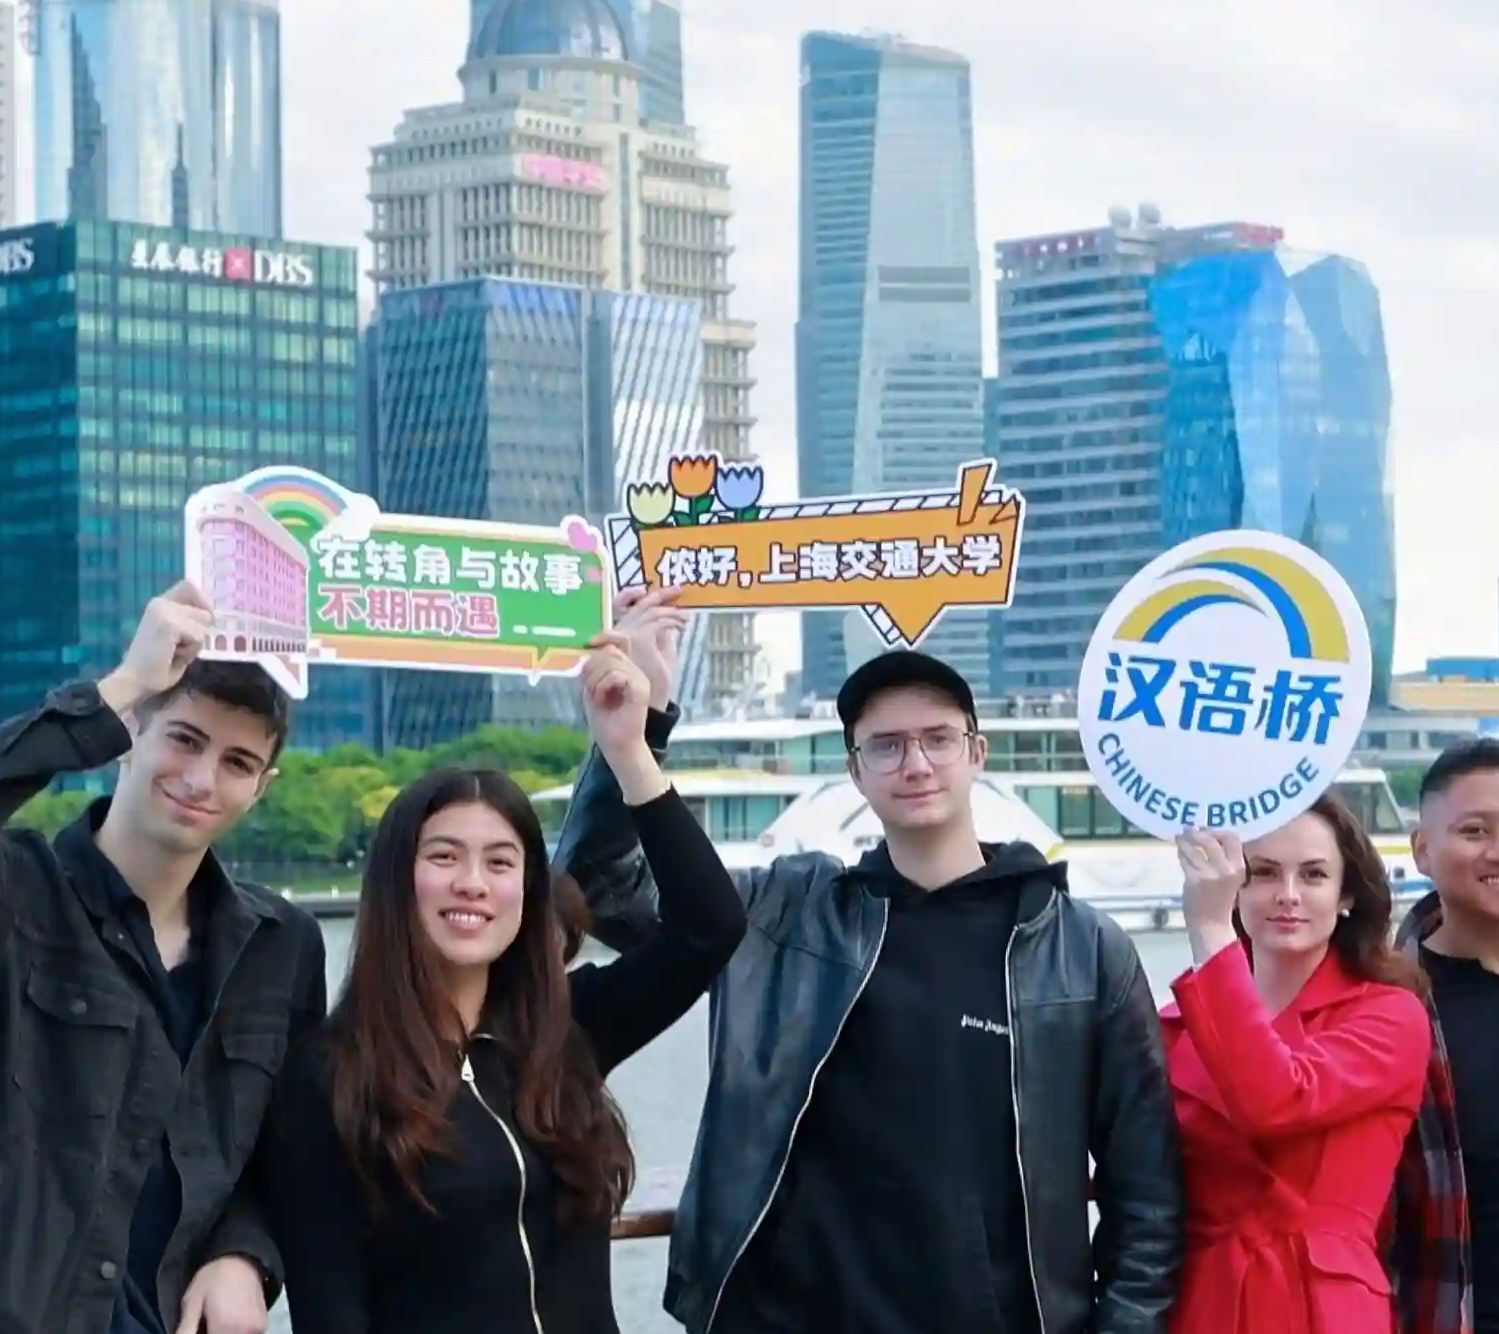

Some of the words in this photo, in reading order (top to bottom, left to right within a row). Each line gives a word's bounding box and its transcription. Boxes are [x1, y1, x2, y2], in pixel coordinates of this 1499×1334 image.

[318, 535, 583, 595] 在转角与故事
[317, 584, 500, 638] 不期而遇
[1098, 652, 1344, 745] 汉语桥
[1098, 732, 1199, 827] CHINESE
[1206, 755, 1321, 828] BRIDGE
